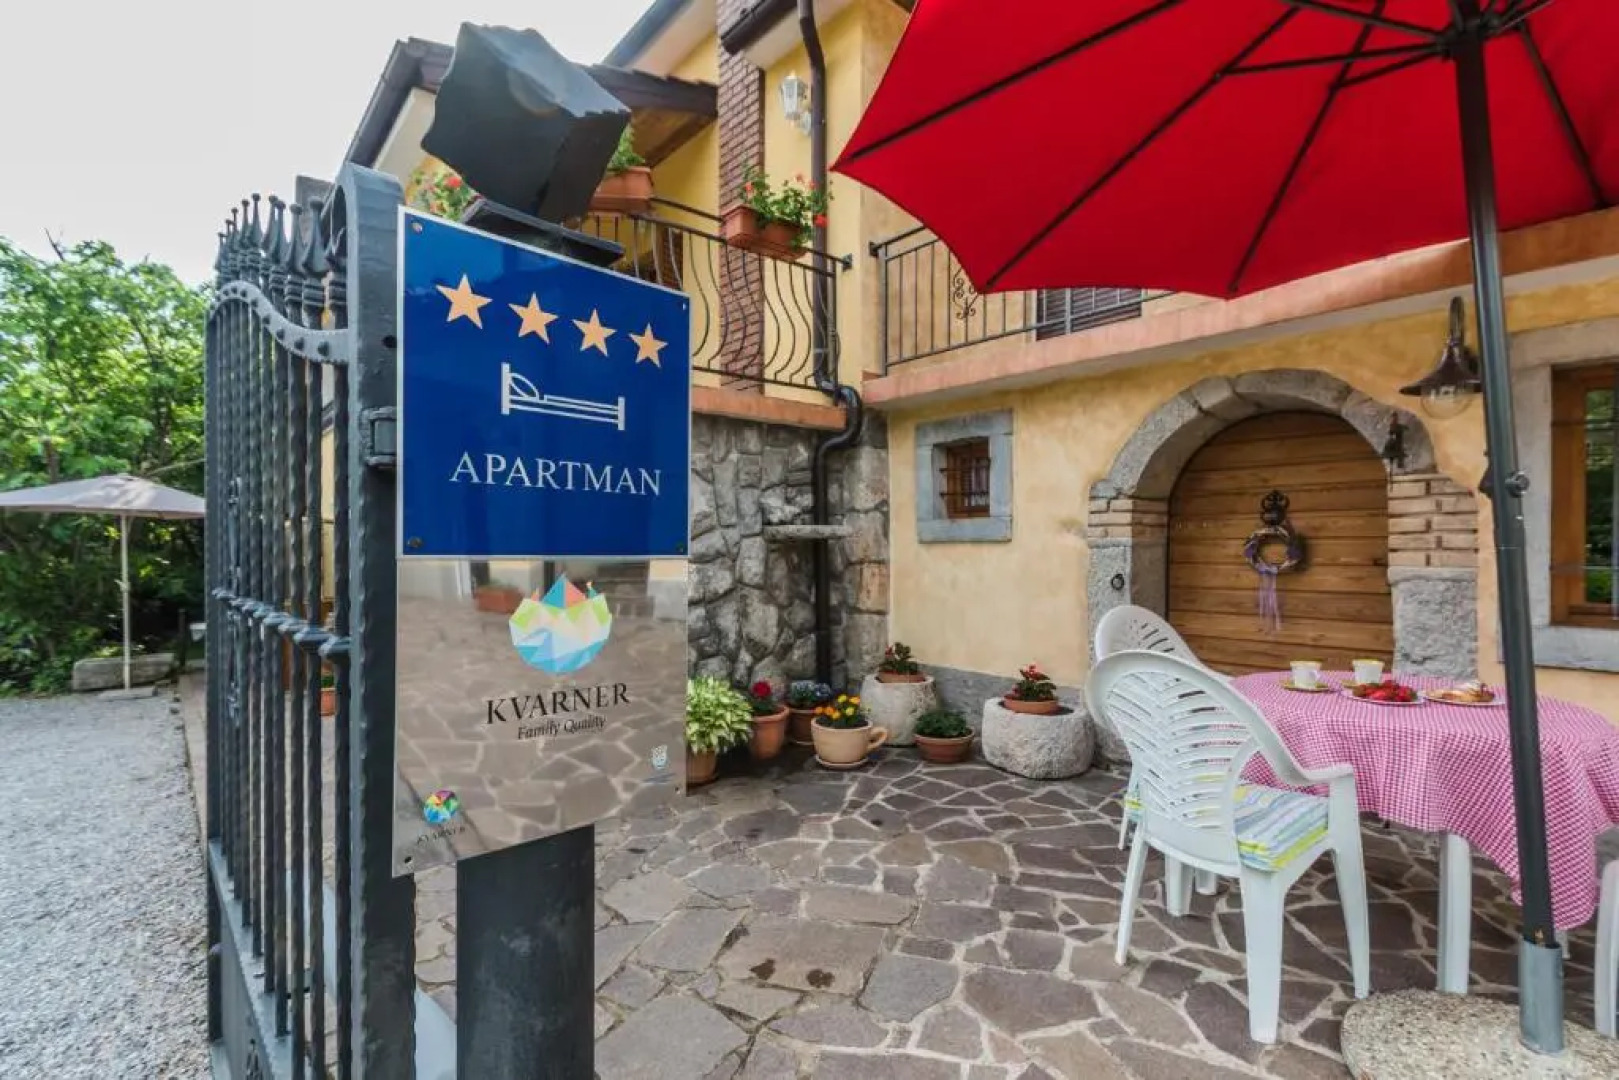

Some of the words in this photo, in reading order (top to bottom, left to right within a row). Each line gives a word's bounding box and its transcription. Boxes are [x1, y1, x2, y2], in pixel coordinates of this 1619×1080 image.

[449, 451, 662, 496] APARTMAN
[486, 682, 630, 724] KVARNER
[518, 719, 559, 740] Family
[564, 714, 606, 733] Quality
